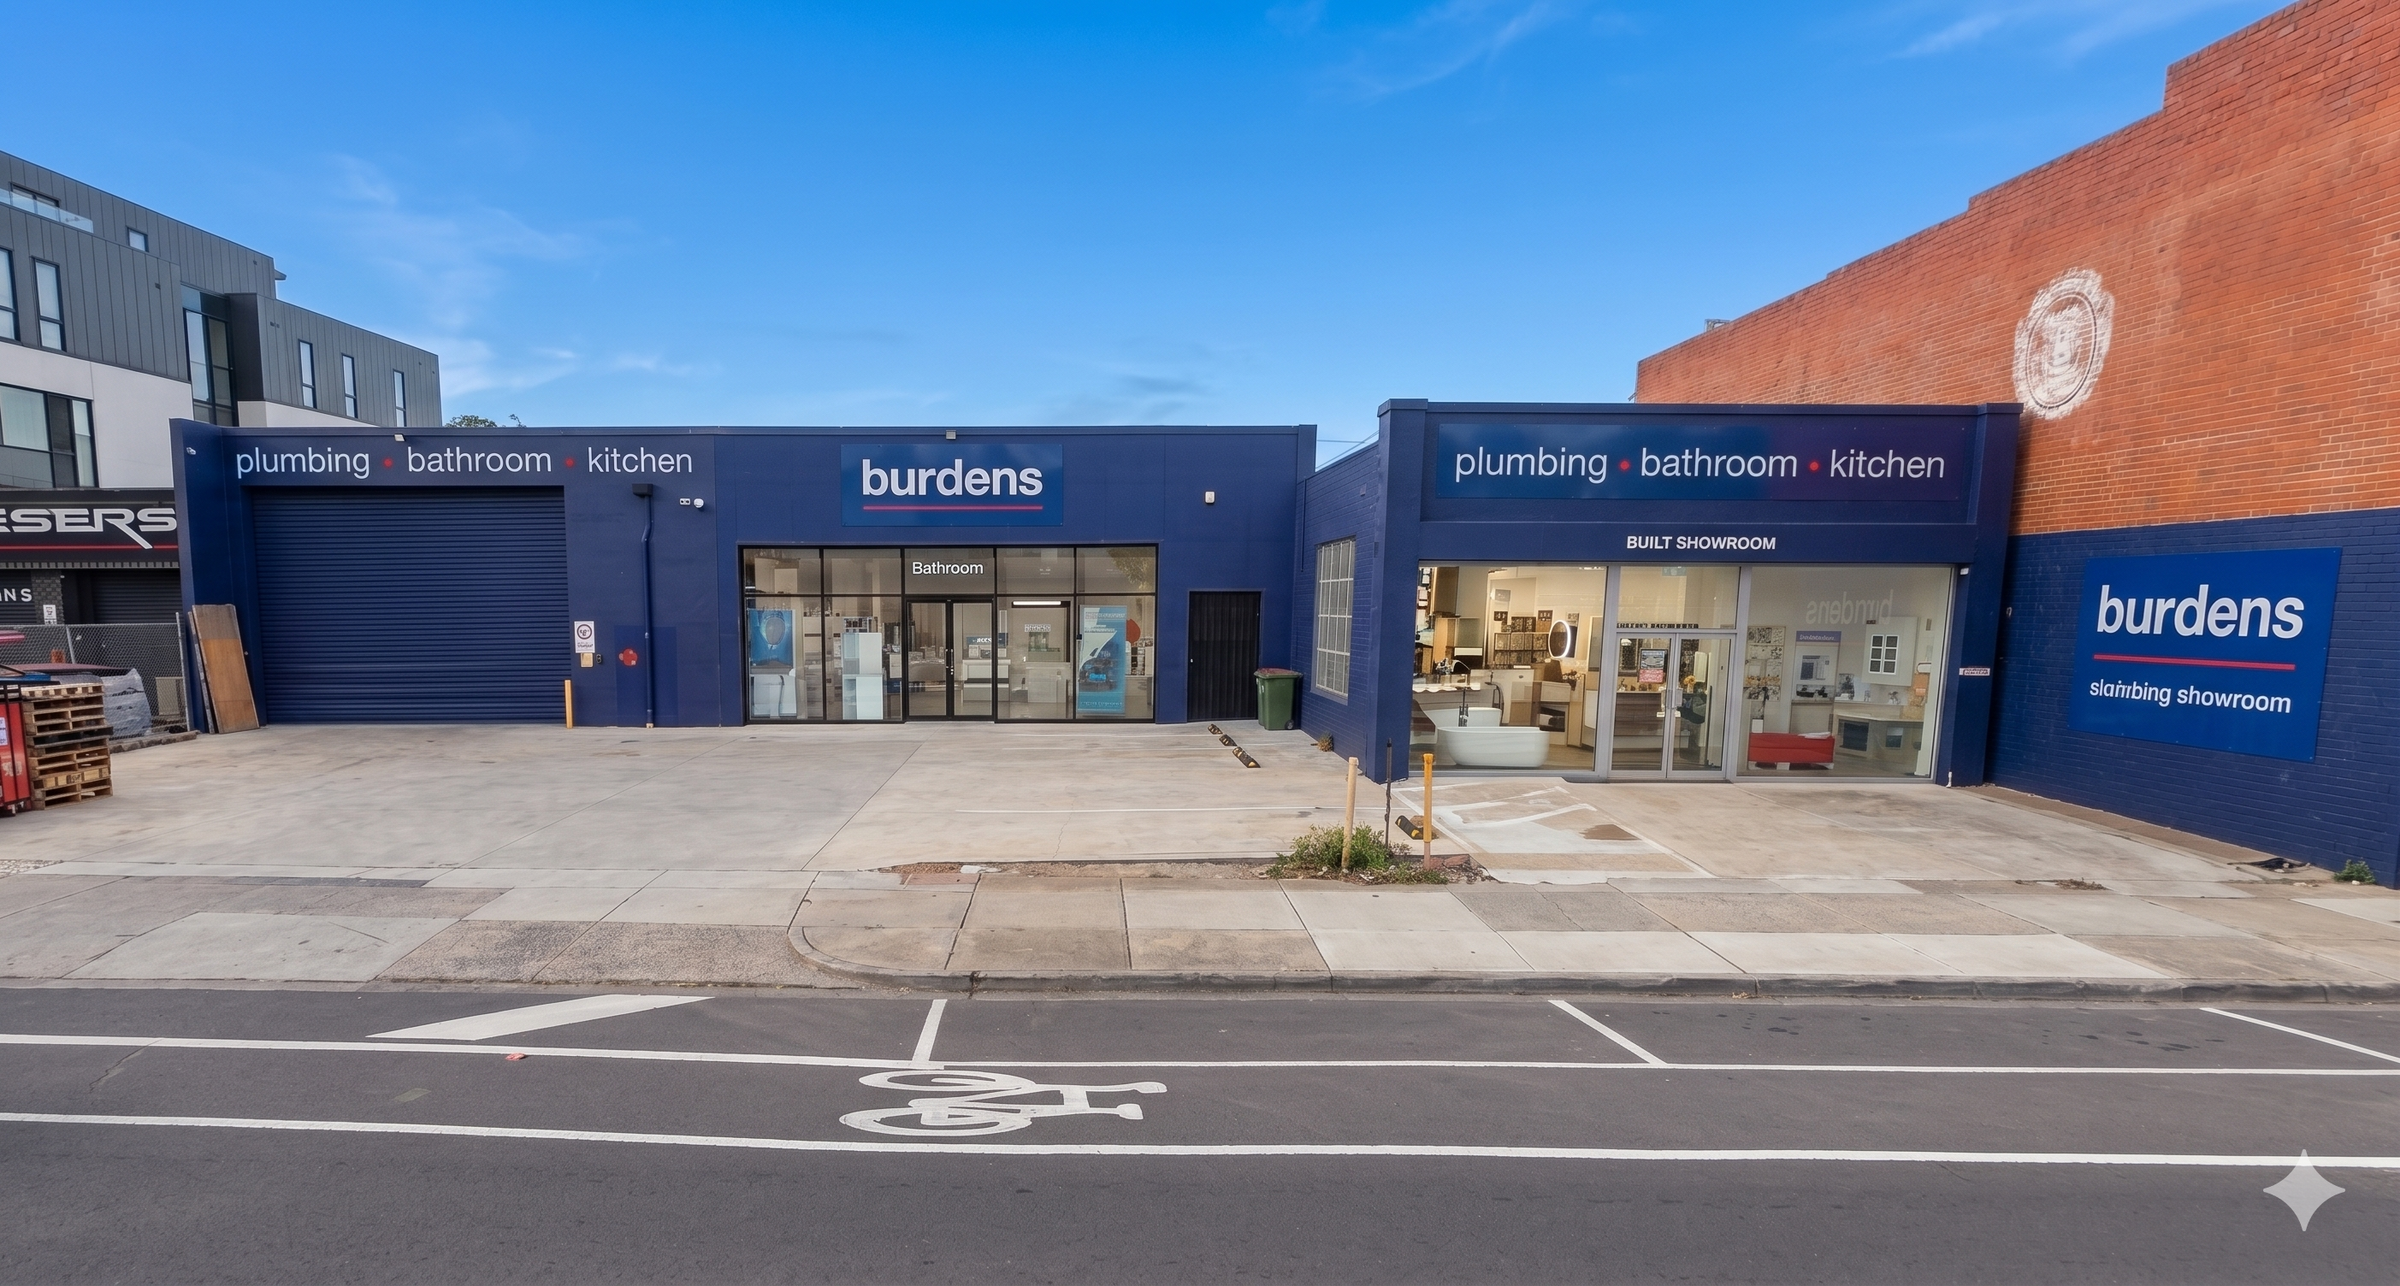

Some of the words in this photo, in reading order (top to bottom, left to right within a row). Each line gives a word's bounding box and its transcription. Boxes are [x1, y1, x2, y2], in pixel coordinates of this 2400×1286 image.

[236, 446, 370, 480] plumbing
[407, 446, 552, 473] bathroom
[588, 446, 693, 473] kitchen
[862, 458, 1043, 496] burdens
[1455, 446, 1609, 484] plumbing
[1641, 447, 1798, 478] bathroom
[1830, 449, 1946, 478] kitchen
[1626, 535, 1673, 550] BUILT
[1675, 535, 1776, 550] SHOWROOM
[912, 561, 984, 575] Bathroom
[2096, 584, 2305, 640] burdens
[2176, 685, 2292, 714] showroom
